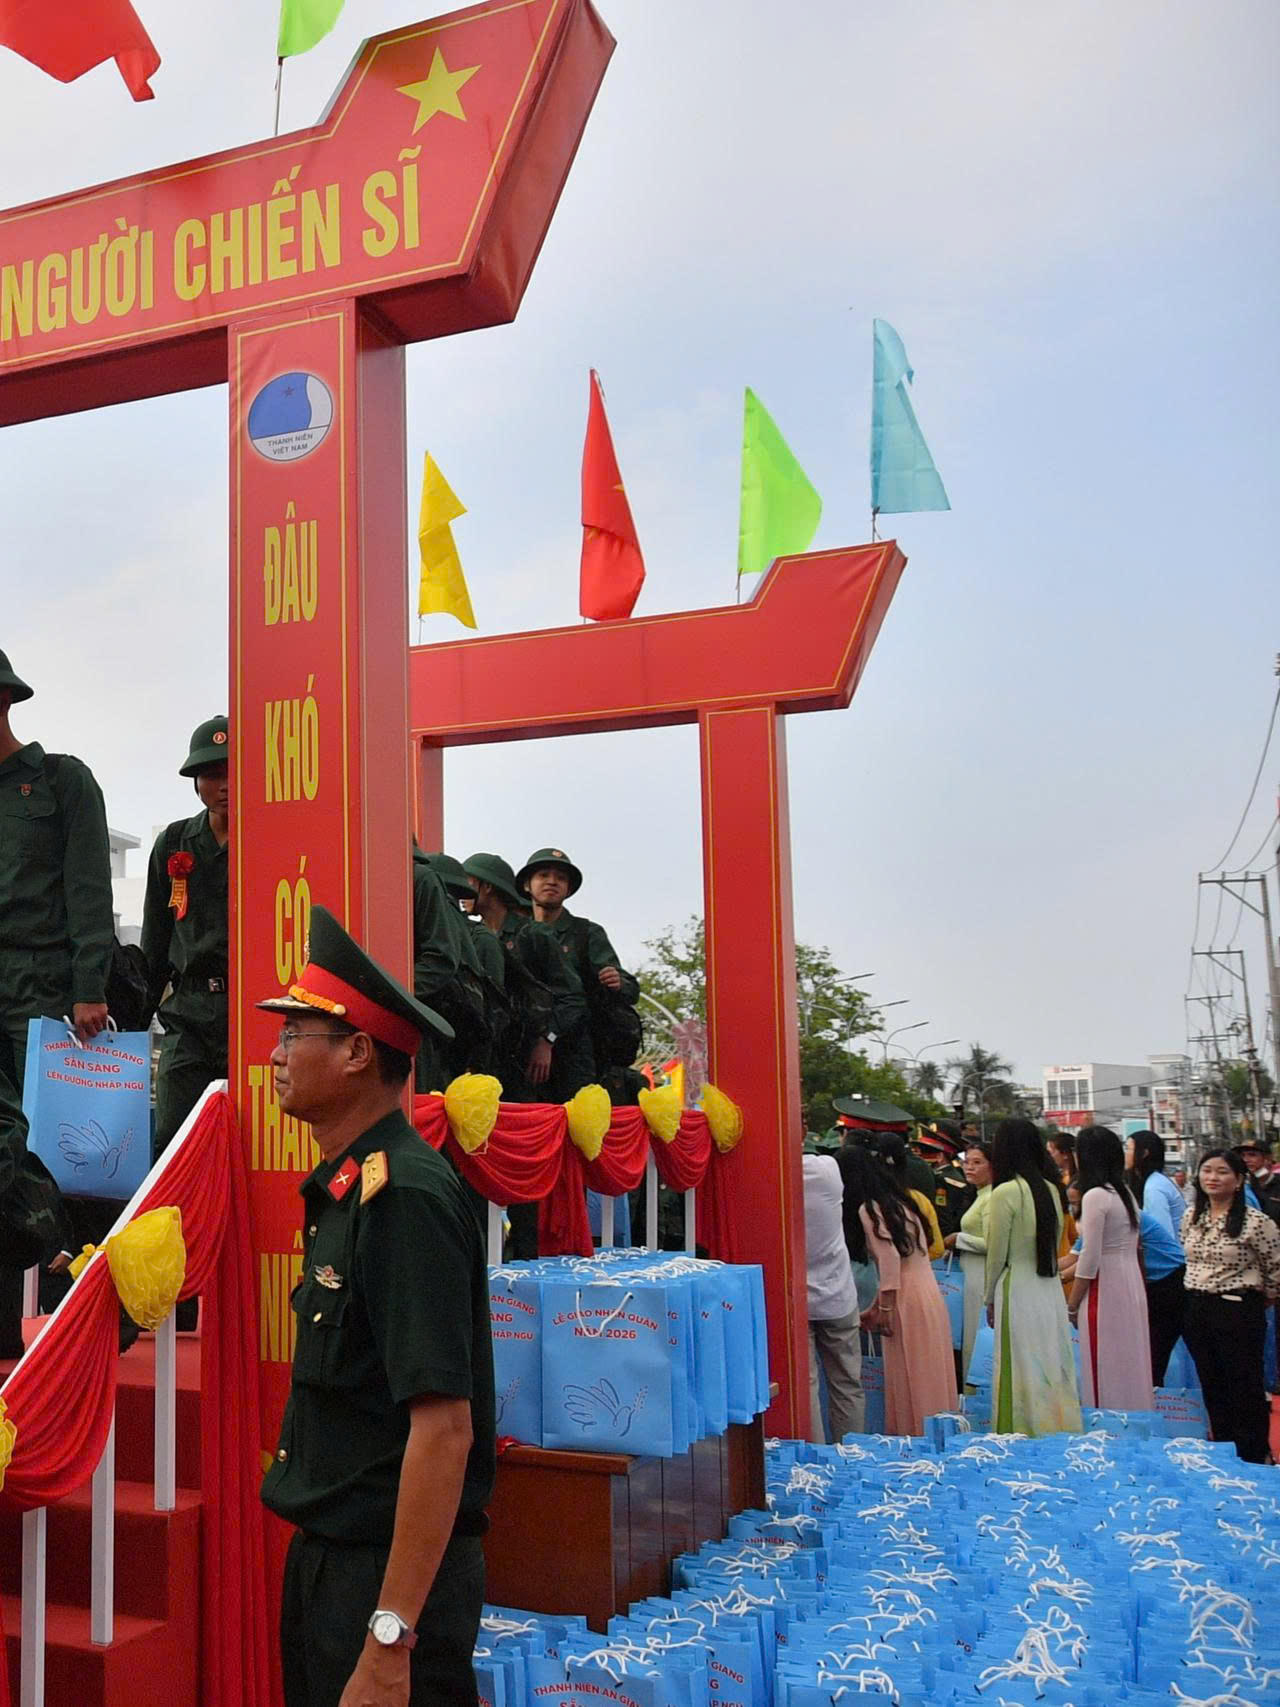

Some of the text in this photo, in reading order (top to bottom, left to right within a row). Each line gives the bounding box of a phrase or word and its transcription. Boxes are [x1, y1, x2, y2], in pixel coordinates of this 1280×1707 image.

[0, 217, 155, 342] NGƯỜI
[173, 164, 341, 301] CHIẾN
[361, 145, 422, 258] SĨ
[291, 443, 308, 452] NAM
[263, 500, 318, 626] ĐÂU
[265, 673, 319, 803] KHÓ
[275, 855, 311, 986] CÓ
[95, 1046, 109, 1055] AN
[112, 1050, 144, 1065] GIANG
[248, 1065, 324, 1171] THA
[260, 1229, 305, 1362] NIÊ
[506, 1298, 536, 1315] GIANG
[606, 1328, 637, 1339] 2026
[534, 1683, 572, 1696] THANH
[602, 1688, 618, 1700] AN
[710, 1661, 745, 1684] GIANG
